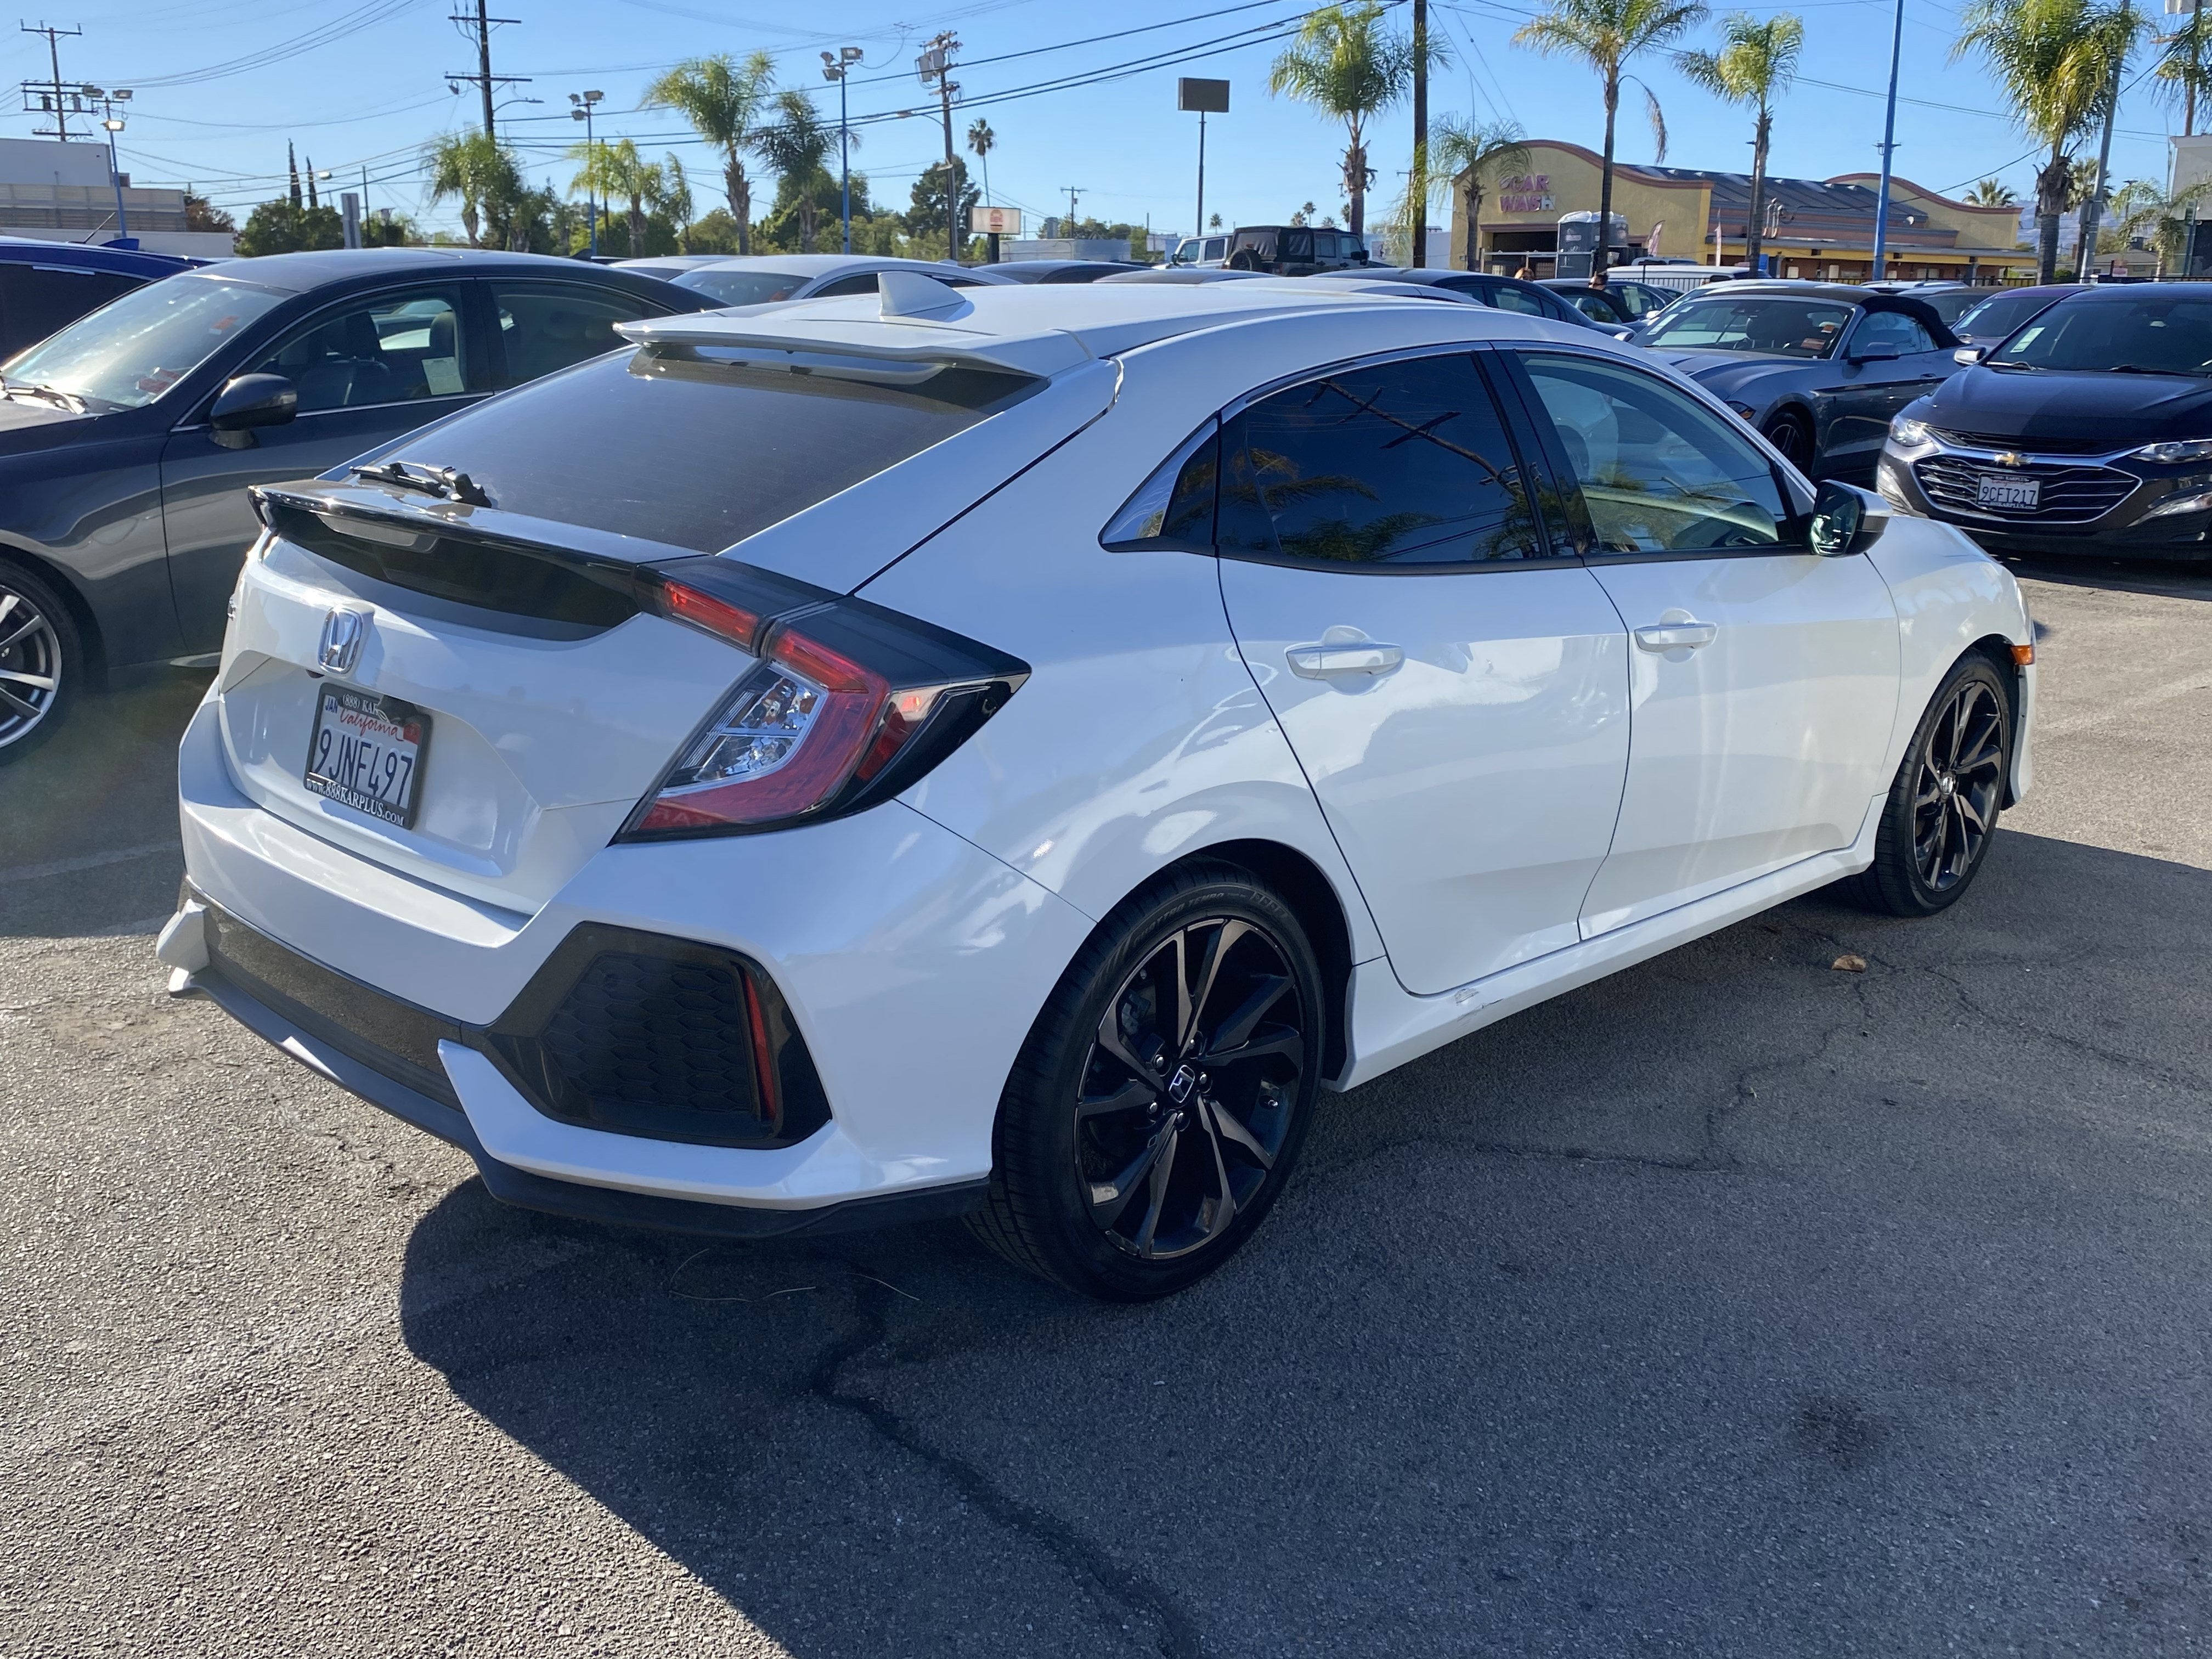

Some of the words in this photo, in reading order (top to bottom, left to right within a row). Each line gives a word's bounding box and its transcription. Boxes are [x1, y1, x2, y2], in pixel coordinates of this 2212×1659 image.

[1510, 175, 1550, 192] CAR
[1499, 195, 1555, 212] WASH
[1981, 486, 2036, 505] 9CFT217
[325, 695, 339, 714] JAN
[342, 693, 360, 709] (888)
[340, 708, 404, 742] California
[314, 729, 413, 806] 9JNF497
